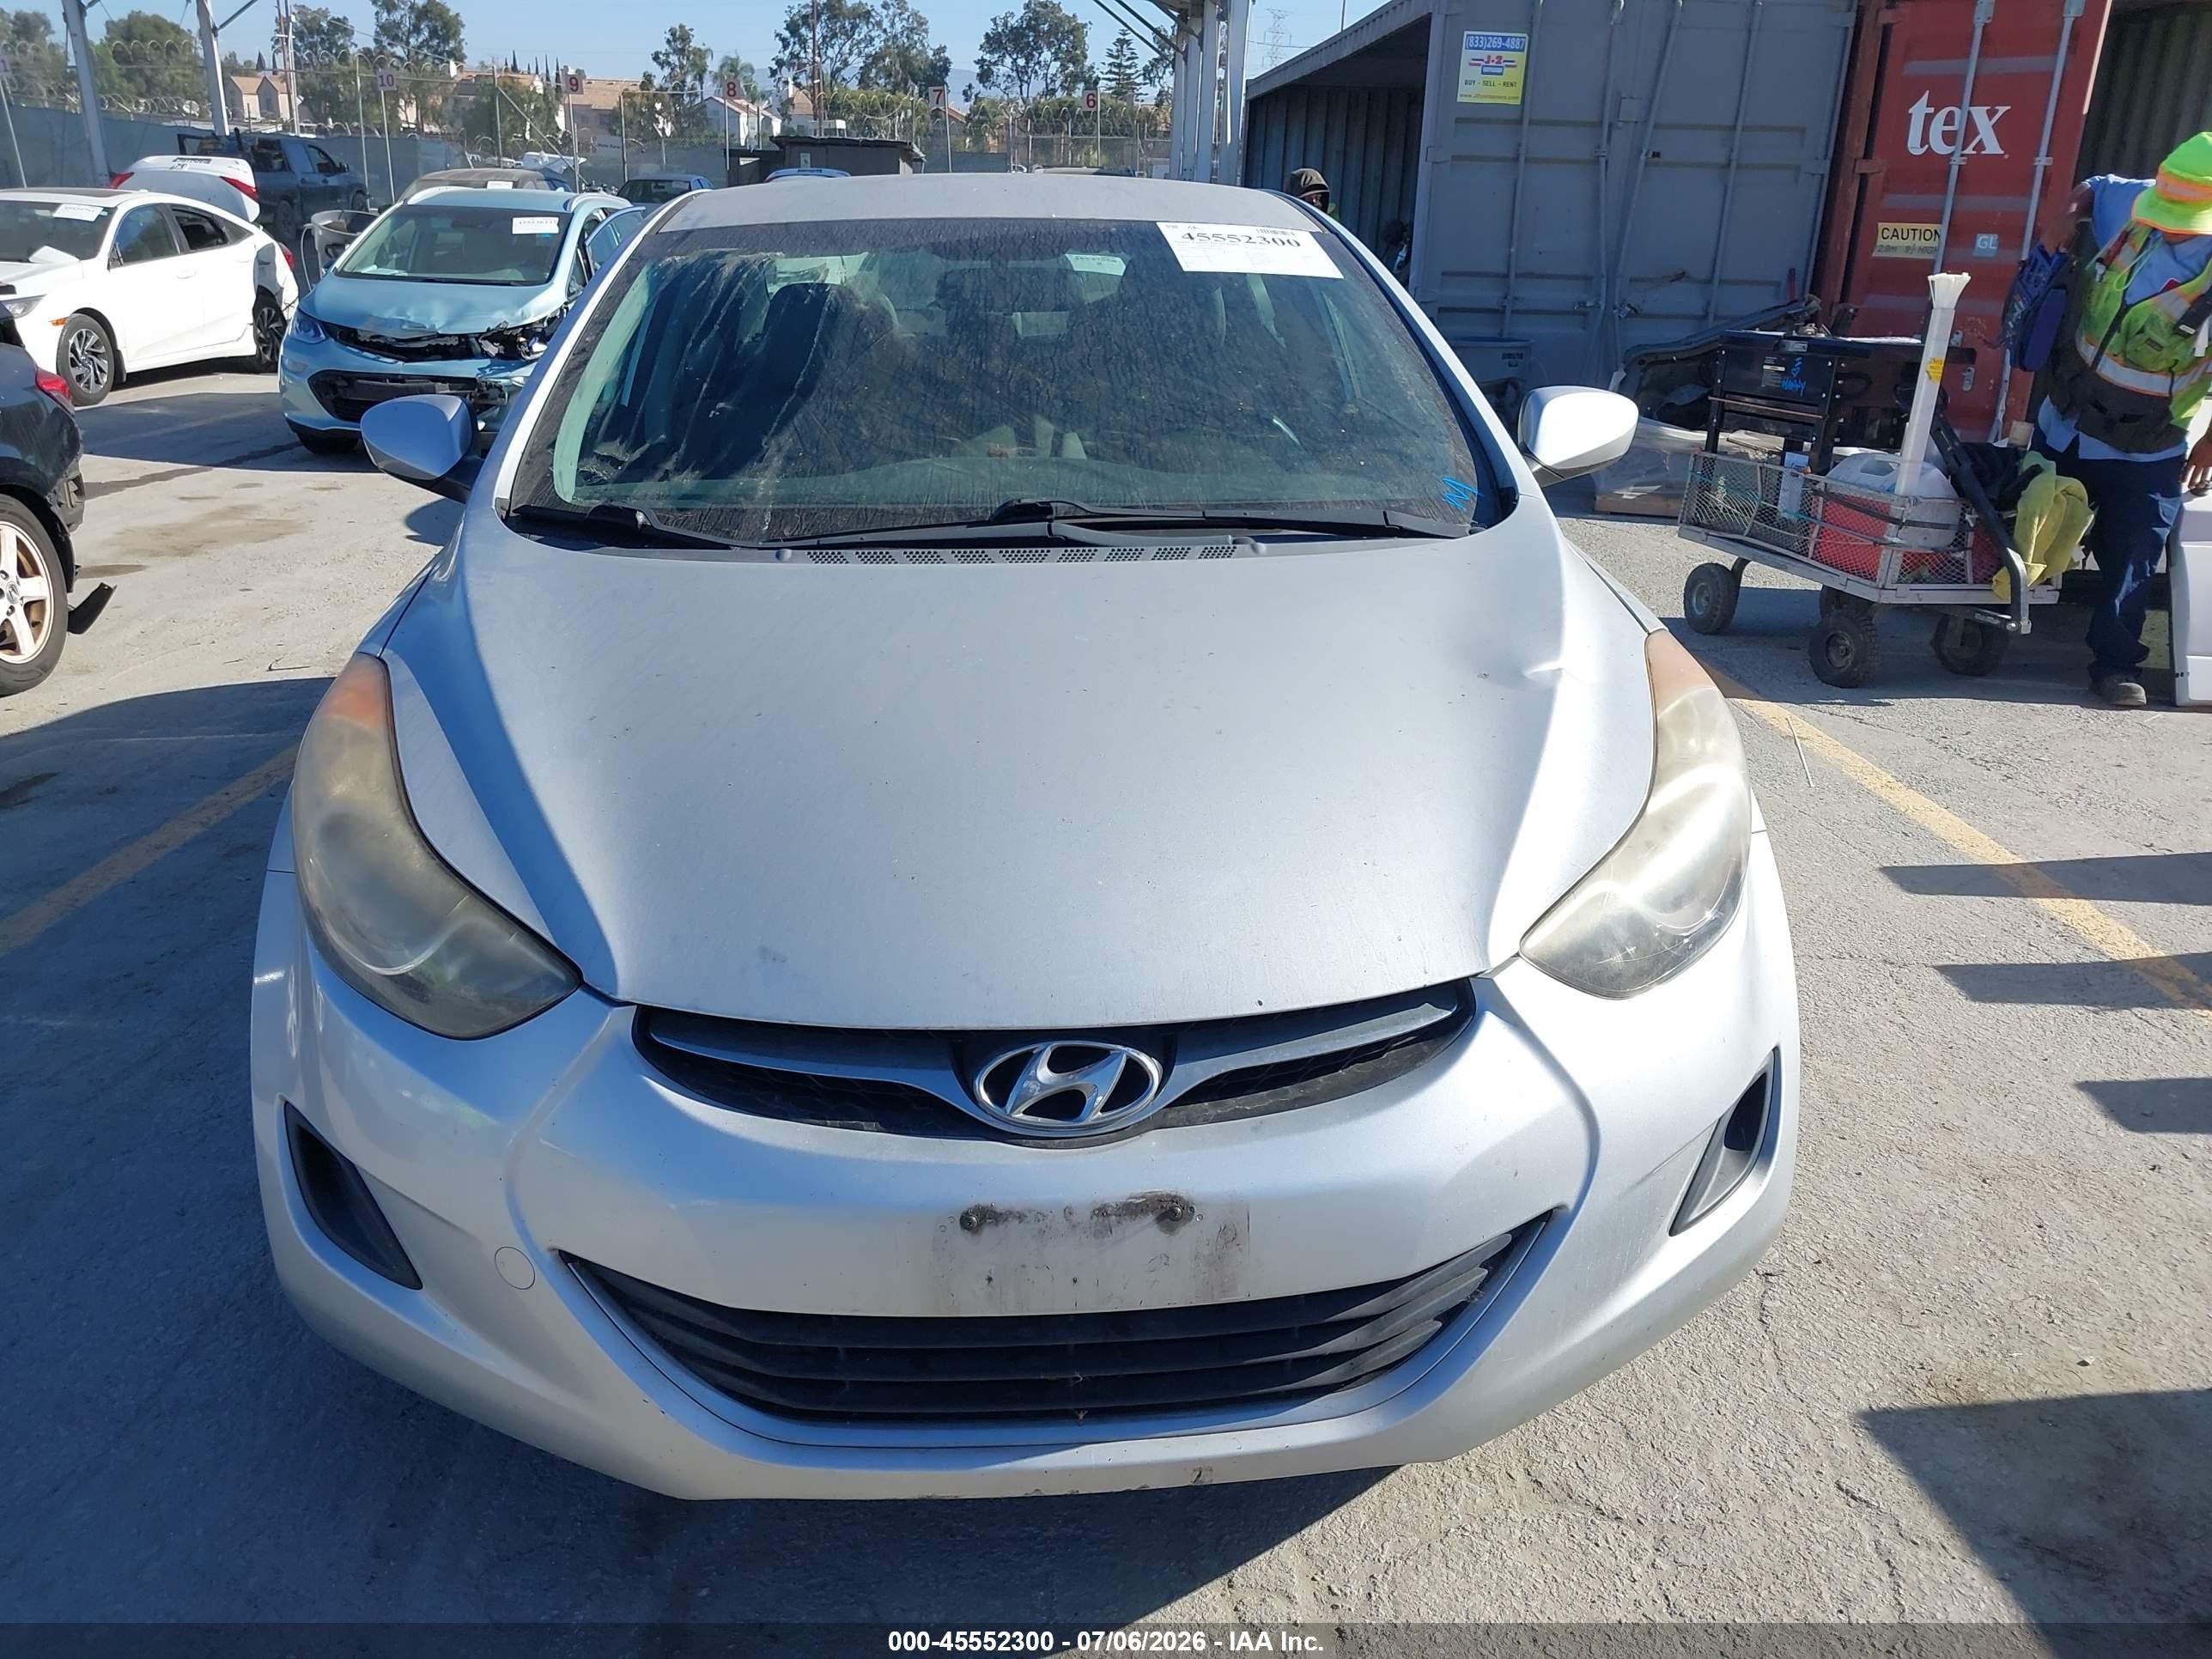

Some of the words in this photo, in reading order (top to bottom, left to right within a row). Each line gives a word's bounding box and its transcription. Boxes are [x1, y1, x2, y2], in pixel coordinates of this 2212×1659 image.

[1466, 36, 1526, 50] (833)269-4887
[380, 74, 395, 88] 10
[568, 74, 580, 93] 9
[726, 82, 737, 97] 8
[933, 88, 943, 105] 7
[1086, 93, 1096, 108] 6
[1907, 89, 2011, 155] tex
[1182, 232, 1302, 247] 45552300
[1881, 227, 1942, 242] CAUTION
[1978, 235, 1997, 249] GL
